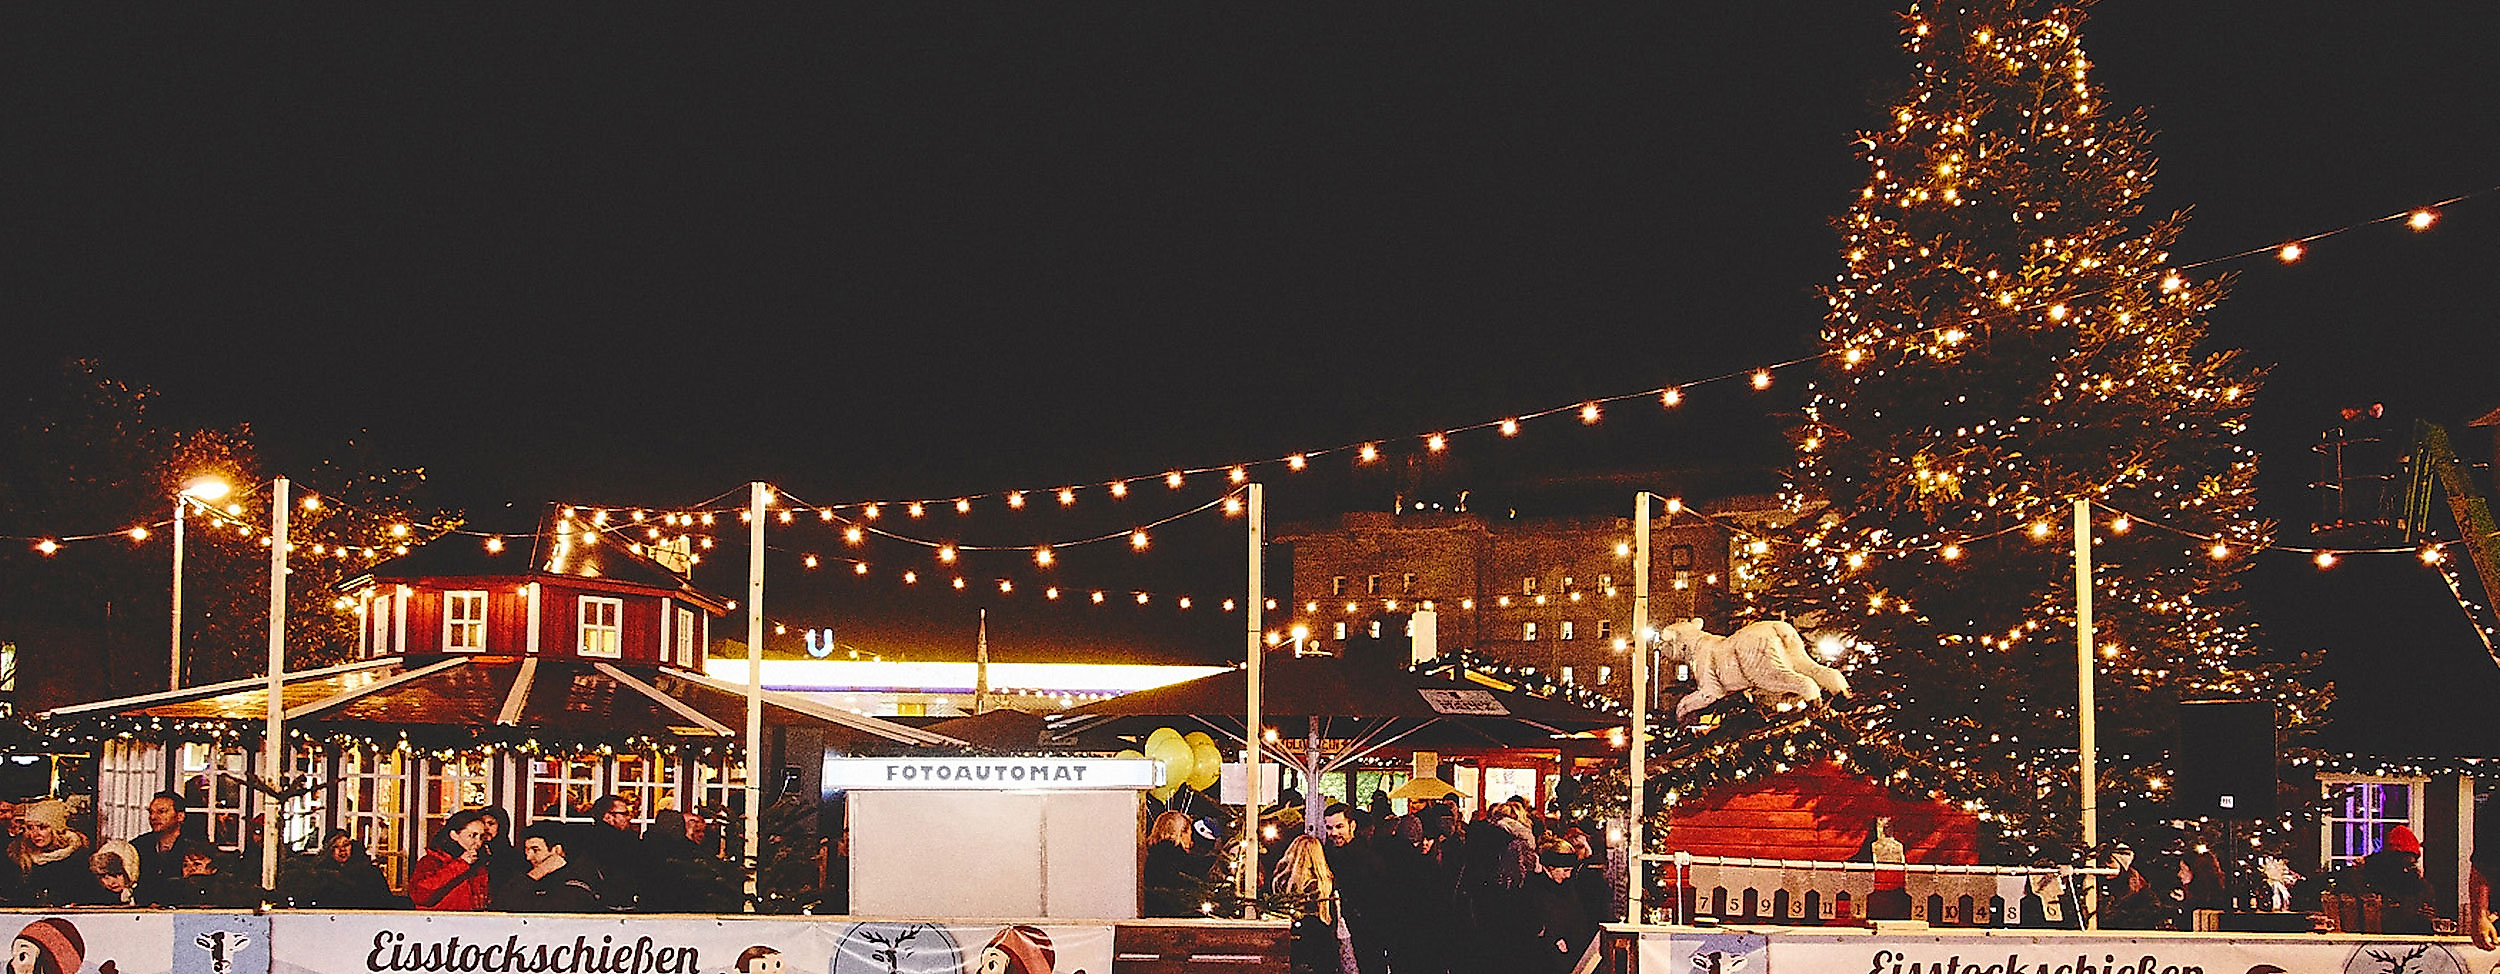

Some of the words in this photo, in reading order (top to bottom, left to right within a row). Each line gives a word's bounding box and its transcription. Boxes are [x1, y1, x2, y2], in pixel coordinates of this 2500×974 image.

[807, 628, 834, 657] U
[886, 765, 1087, 781] FOTOAUTOMAT
[1699, 896, 1709, 910] 7
[1729, 898, 1739, 911] 5
[1761, 899, 1771, 912] 9
[1792, 900, 1802, 914] 3
[1822, 902, 1833, 915] 11
[1855, 902, 1862, 916] 1
[1914, 905, 1924, 919] 2
[1945, 905, 1958, 919] 10
[1975, 906, 1987, 919] 4
[2007, 906, 2017, 920] 8
[366, 929, 701, 974] Eisstockschießen
